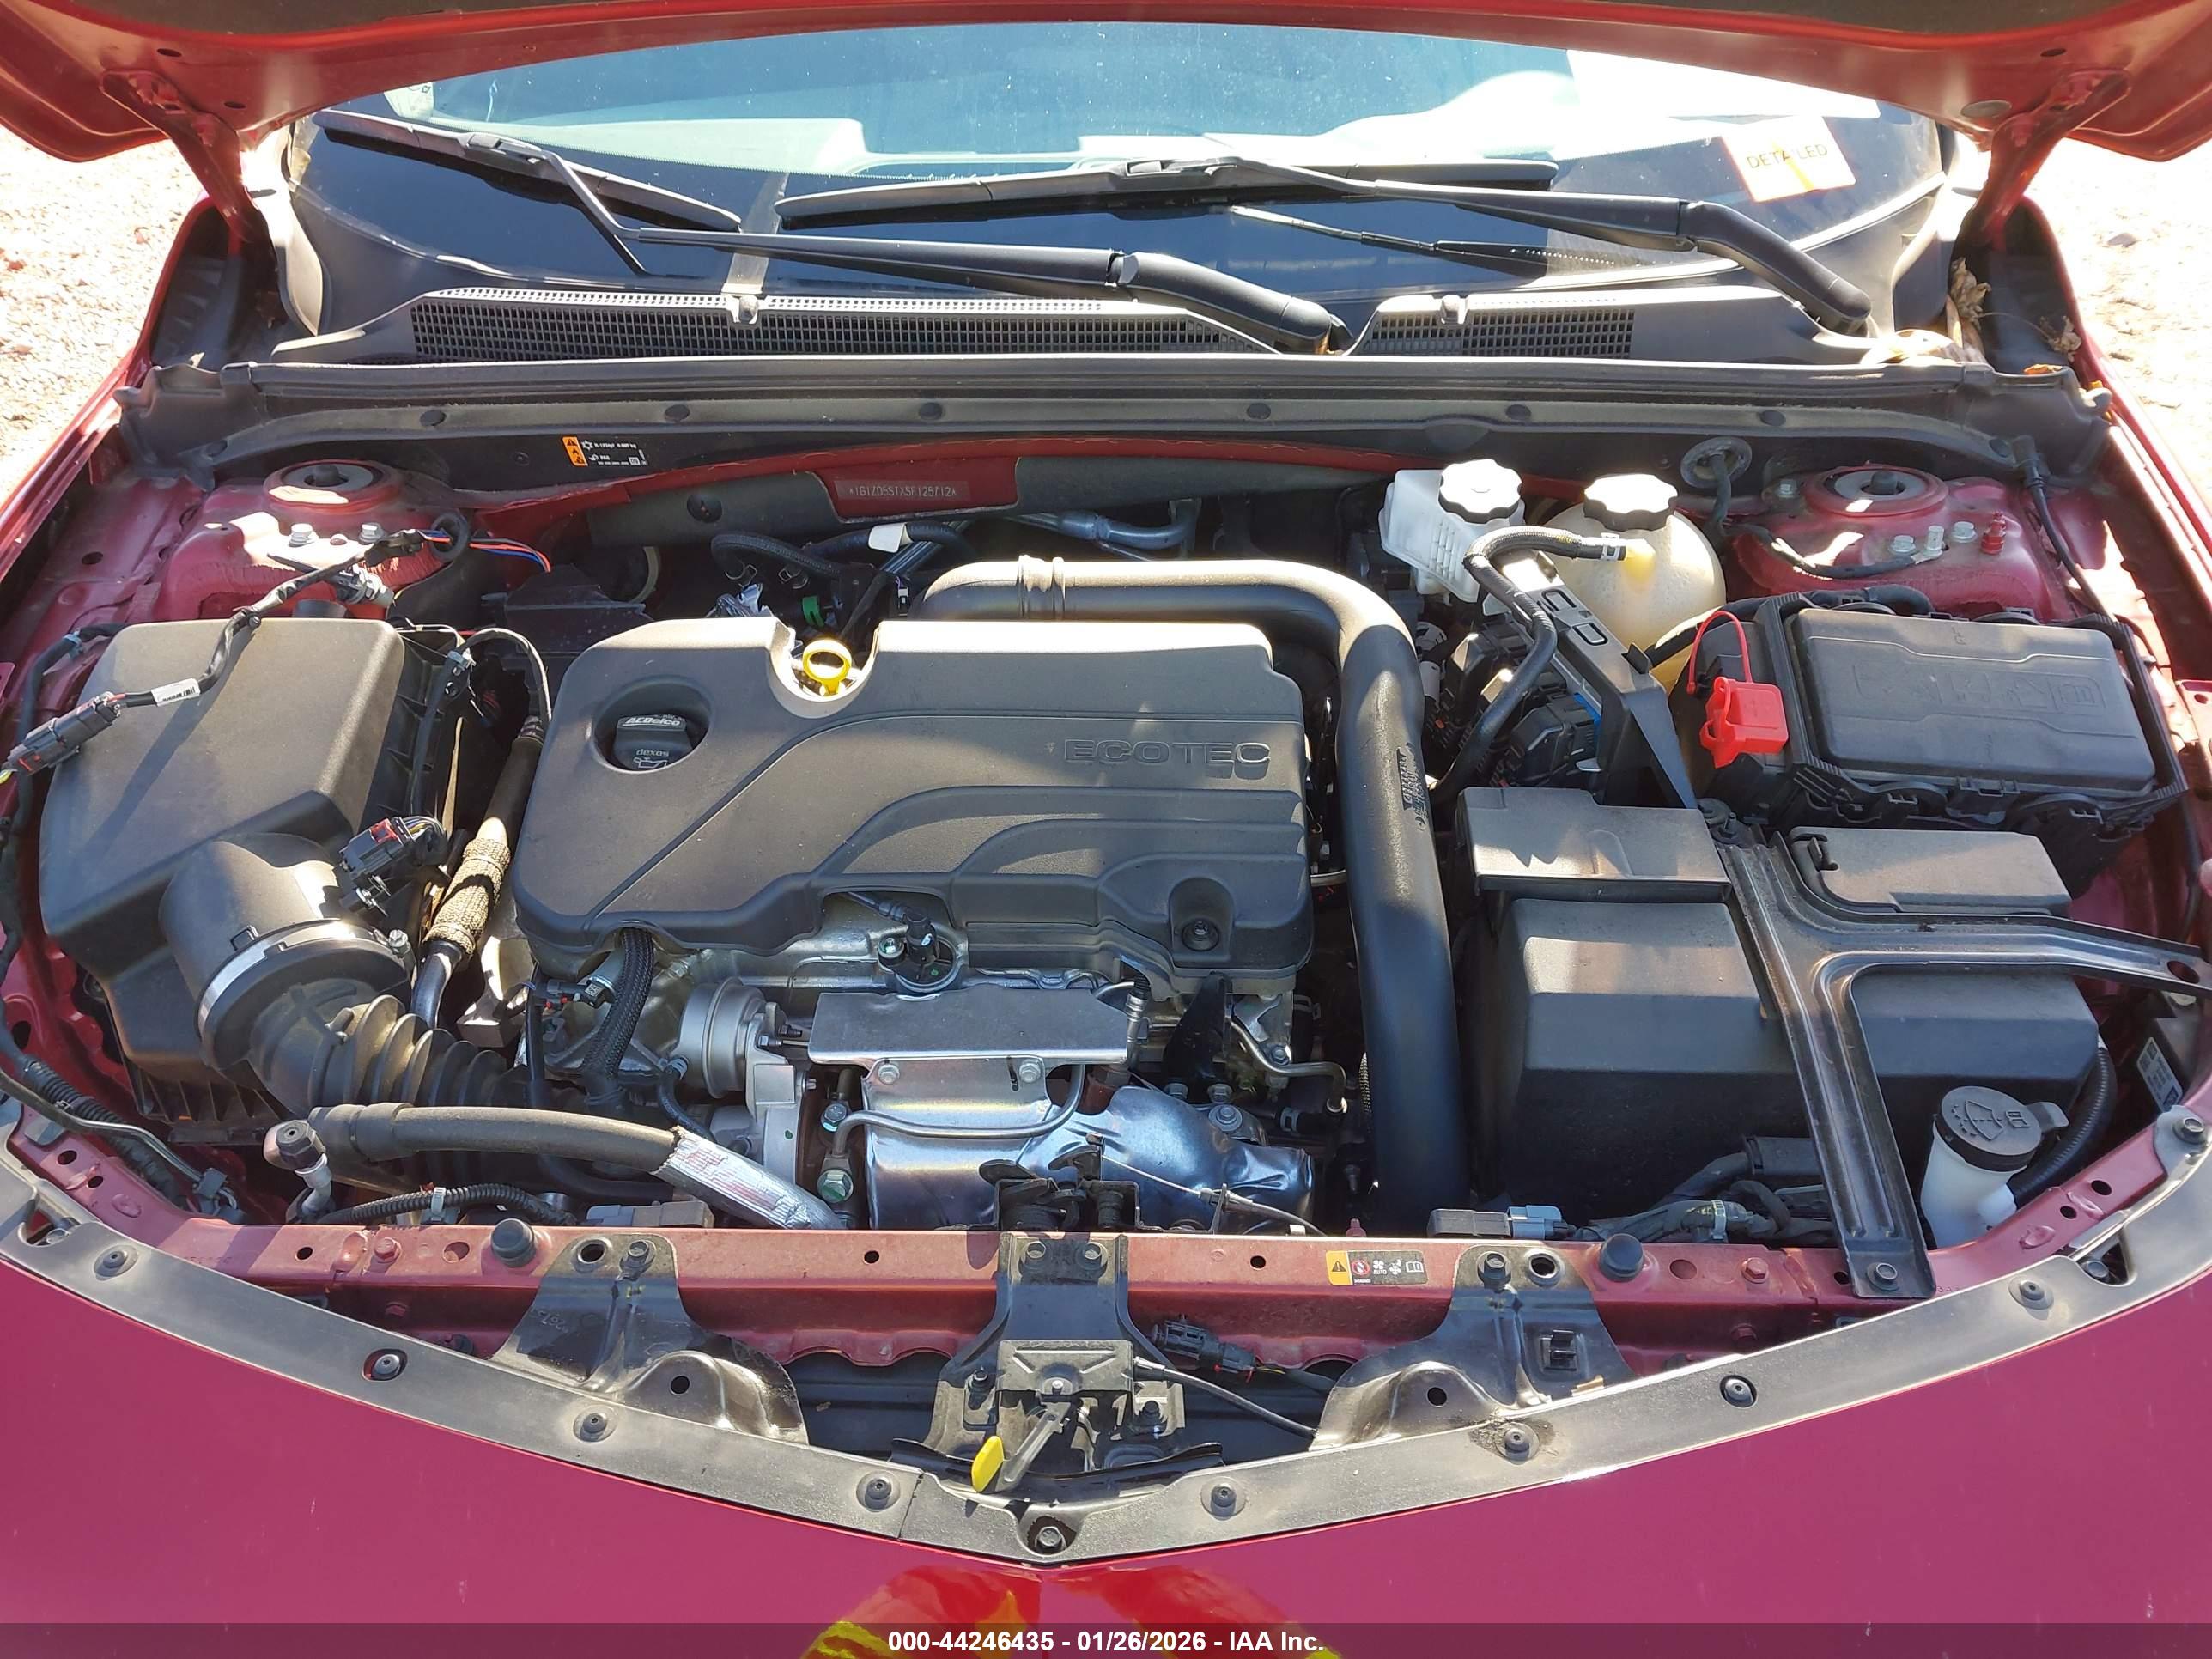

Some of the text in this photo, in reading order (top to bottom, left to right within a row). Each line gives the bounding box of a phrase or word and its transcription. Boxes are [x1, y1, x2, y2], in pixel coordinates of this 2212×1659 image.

[1746, 143, 1828, 168] DETALED
[625, 716, 681, 726] ACDelco
[1065, 739, 1271, 764] ECOTEC
